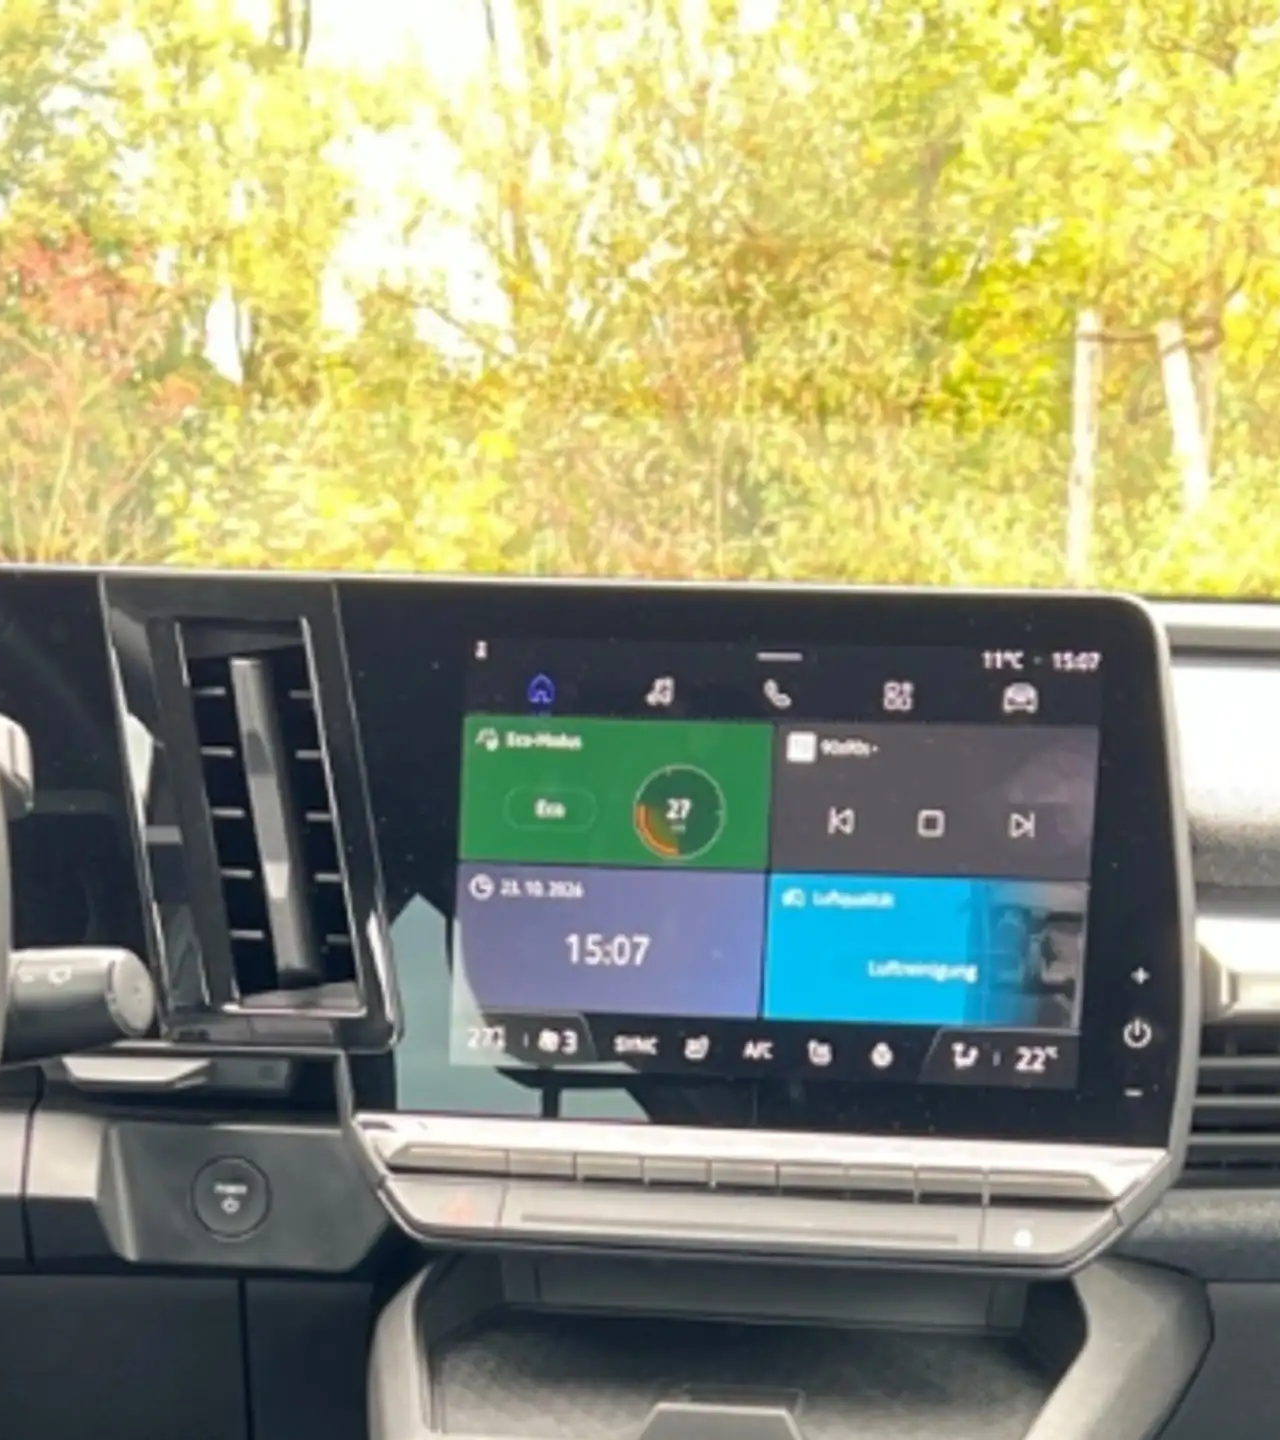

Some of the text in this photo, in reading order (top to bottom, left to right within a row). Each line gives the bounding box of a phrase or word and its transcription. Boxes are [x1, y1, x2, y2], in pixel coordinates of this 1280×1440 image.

[1052, 650, 1102, 671] 15:07
[534, 798, 566, 819] Eco
[665, 798, 692, 820] 27
[566, 932, 651, 967] 15:07
[614, 1034, 658, 1055] SYNC
